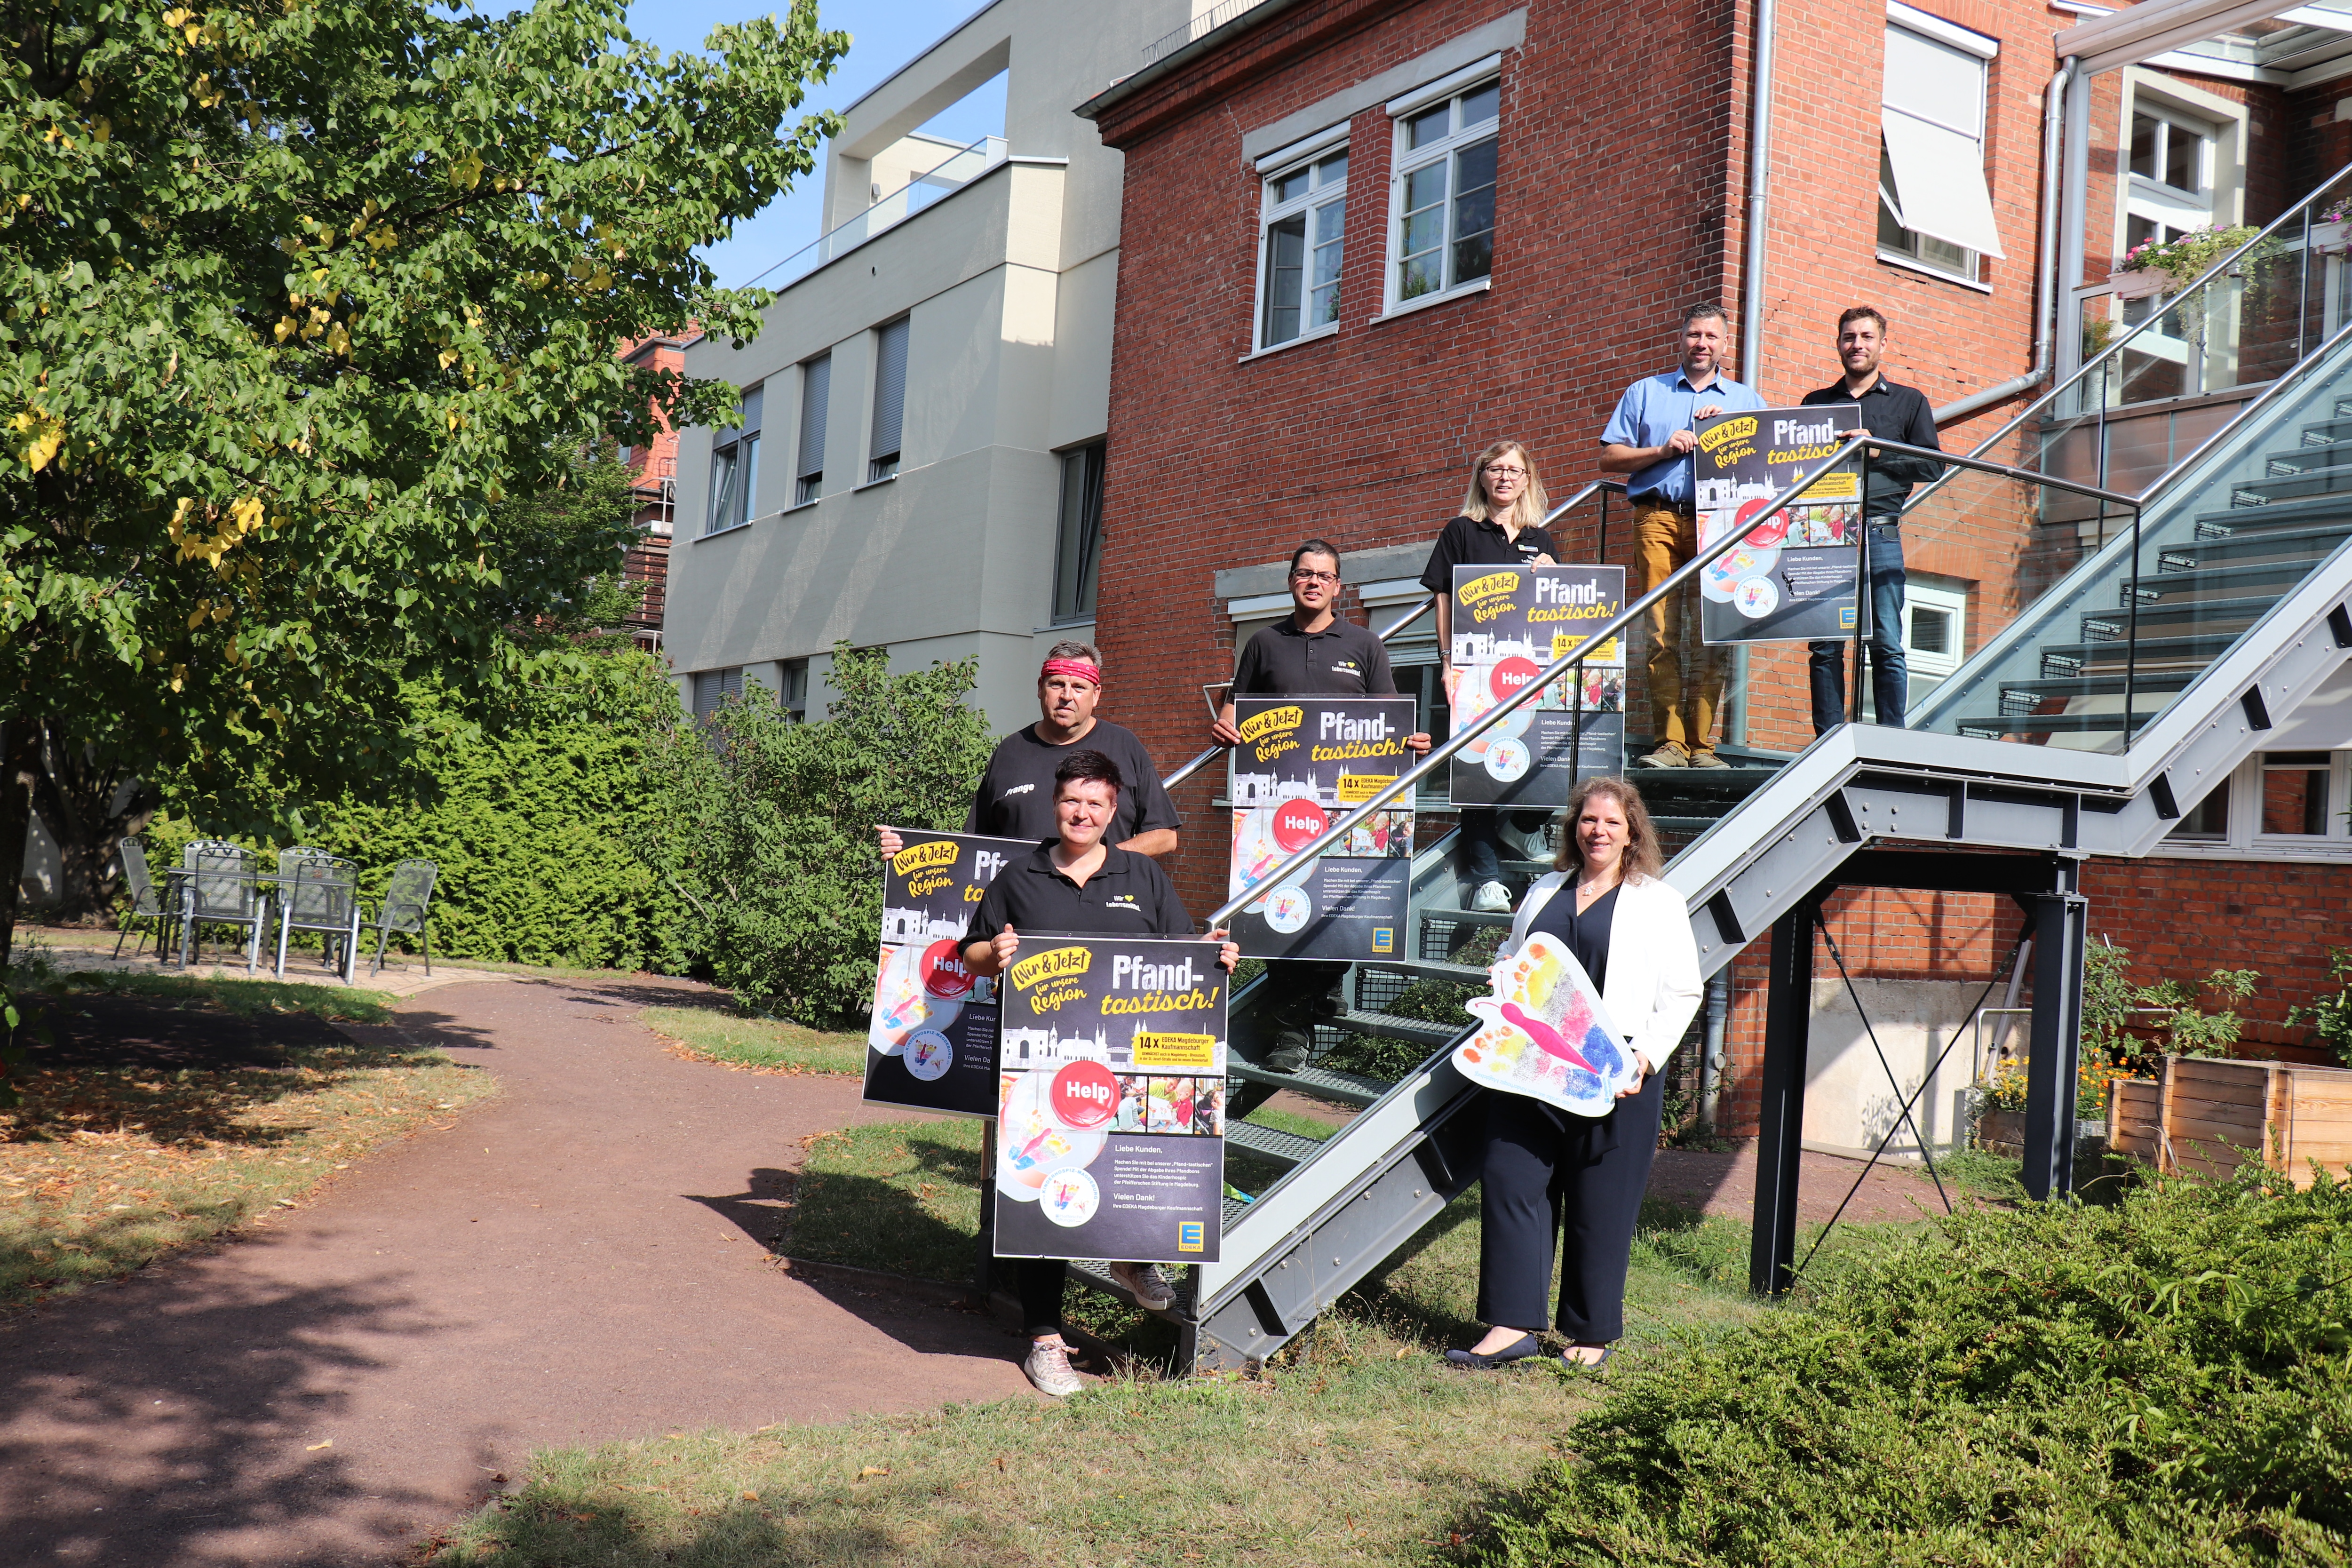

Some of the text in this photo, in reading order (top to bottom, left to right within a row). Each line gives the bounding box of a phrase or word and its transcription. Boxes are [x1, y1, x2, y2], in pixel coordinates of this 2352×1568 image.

[1700, 420, 1754, 448] Wir & Jetzt
[1714, 447, 1756, 468] Region
[1717, 439, 1749, 455] für unsere
[1767, 440, 1843, 465] tastisc
[1460, 575, 1516, 601] Wir & Jetzt
[1535, 577, 1606, 604] Pfand-
[1473, 602, 1517, 623] Region
[1477, 599, 1487, 609] für
[1527, 601, 1618, 622] tastisch!
[1557, 638, 1566, 647] 14
[1242, 709, 1299, 738] Wir & Jetzt
[1320, 712, 1395, 740] Pfand-
[1259, 731, 1293, 747] für unsere
[1311, 736, 1408, 761] tastisch!
[1255, 740, 1300, 762] Region
[1005, 783, 1034, 796] Prange
[1343, 778, 1352, 788] 14
[1285, 816, 1319, 833] Help
[896, 844, 955, 871] Wir & Jetzt
[908, 875, 954, 897] Region
[913, 870, 923, 882] für
[1014, 951, 1087, 984] Wir & Jetzt
[1112, 955, 1204, 991] Pfand-
[1035, 977, 1079, 996] für unsere
[1030, 987, 1087, 1014] Region
[1101, 987, 1219, 1015] tastisch!
[1139, 1036, 1159, 1049] 14 x
[1067, 1081, 1109, 1103] Help
